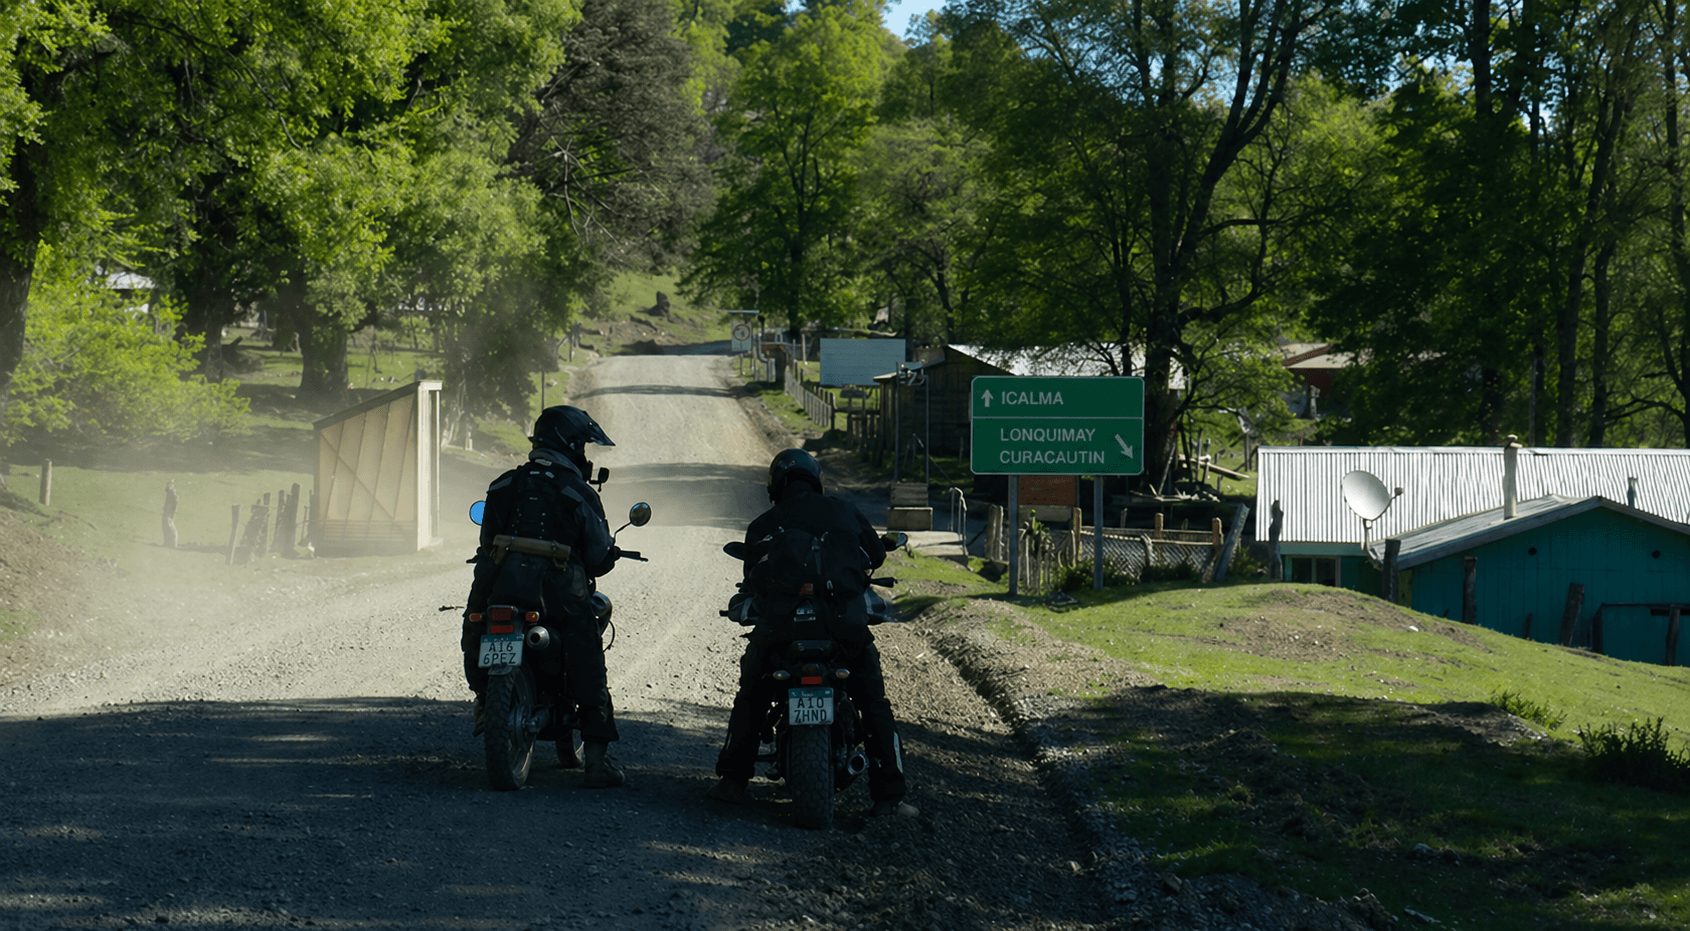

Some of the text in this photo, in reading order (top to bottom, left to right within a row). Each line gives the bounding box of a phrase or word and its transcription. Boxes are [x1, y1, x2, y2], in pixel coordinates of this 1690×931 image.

[1001, 391, 1064, 405] ICALMA
[1000, 428, 1096, 442] LONQUIMAY
[999, 450, 1105, 464] CURACAUTIN
[484, 652, 516, 664] 6PEZ
